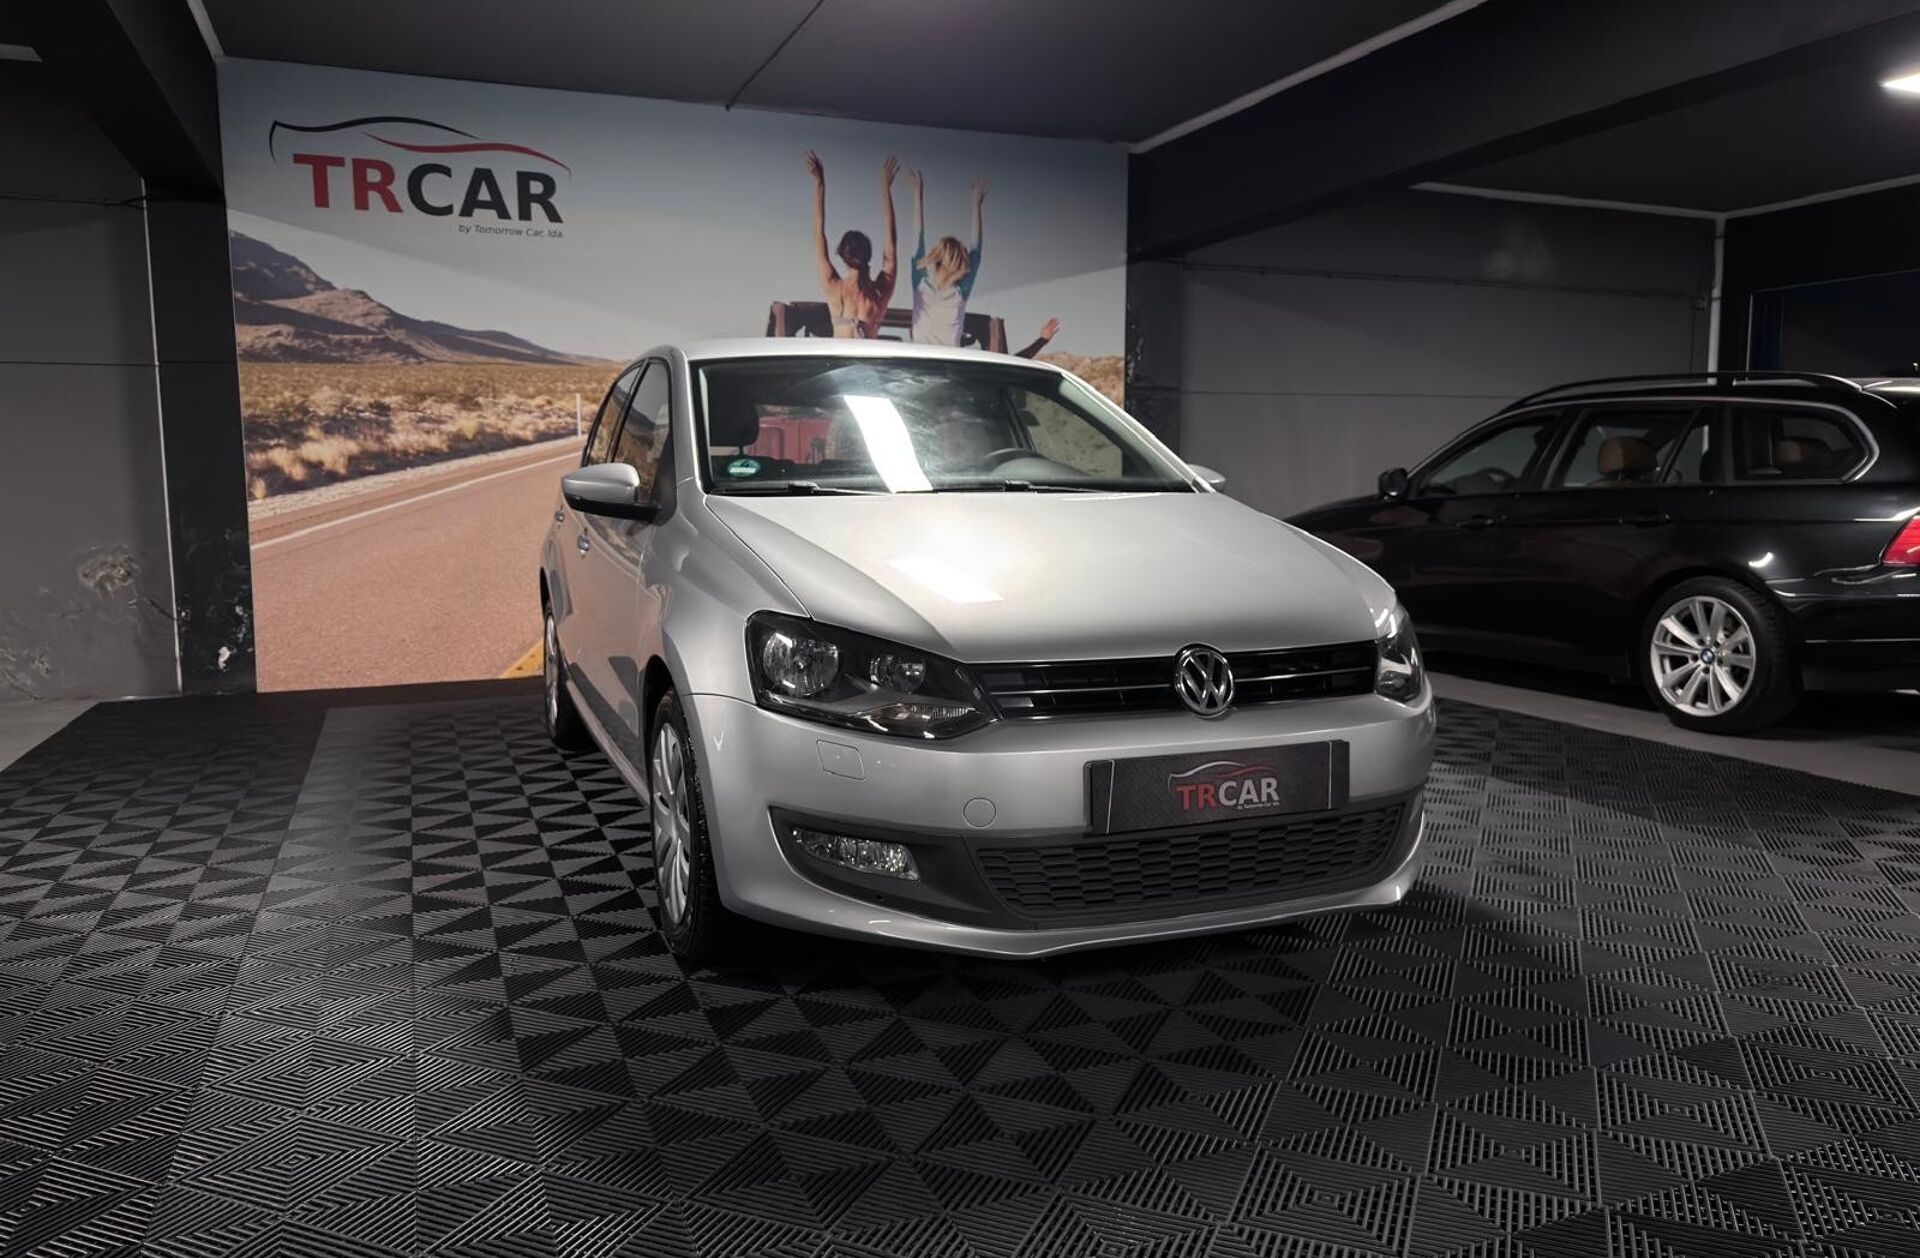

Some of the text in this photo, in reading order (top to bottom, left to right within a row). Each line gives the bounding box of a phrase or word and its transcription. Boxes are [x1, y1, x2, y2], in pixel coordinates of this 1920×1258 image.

[293, 153, 564, 223] TRCAR
[458, 224, 473, 235] by
[475, 224, 523, 237] Tomorrow
[1177, 777, 1280, 810] TRCAR
